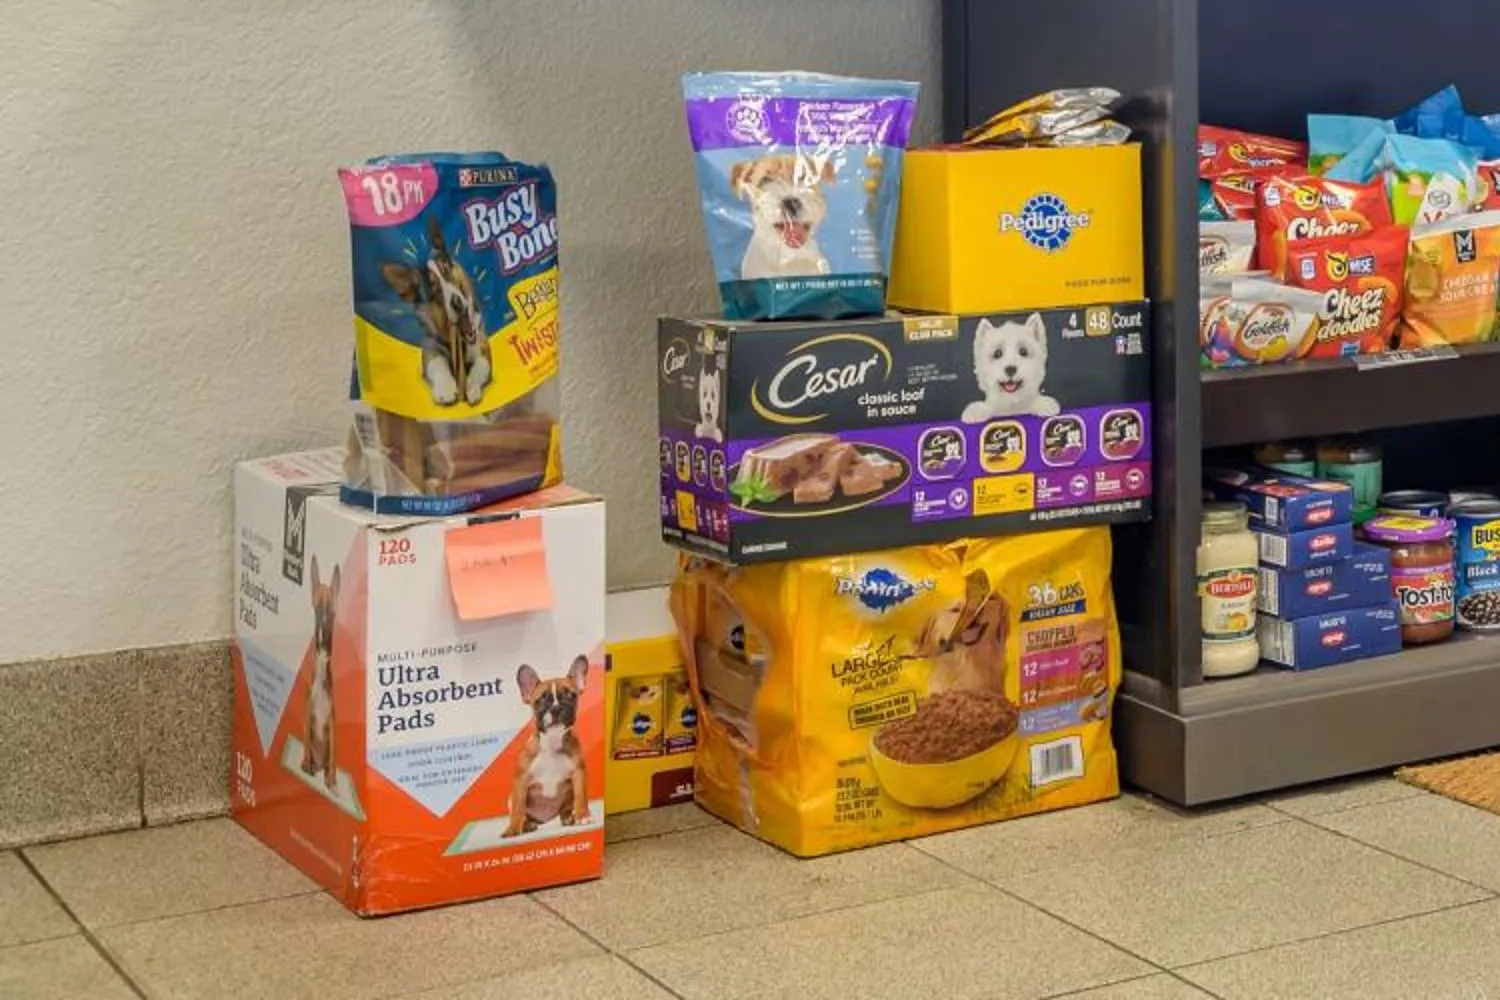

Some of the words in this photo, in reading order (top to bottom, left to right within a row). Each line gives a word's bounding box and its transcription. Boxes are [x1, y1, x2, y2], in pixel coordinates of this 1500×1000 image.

[362, 172, 403, 216] 18
[465, 183, 537, 245] Busy
[1000, 209, 1090, 236] Pedigree
[1468, 283, 1497, 297] CREA
[1325, 286, 1384, 317] Cheez
[1069, 312, 1077, 328] 4
[1089, 312, 1108, 330] 48
[1112, 311, 1143, 328] Count
[1243, 319, 1290, 338] Goldfish
[769, 354, 879, 408] Cesar
[858, 391, 897, 405] classic
[901, 388, 925, 402] loaf
[867, 406, 878, 417] in
[881, 404, 917, 416] sauce
[379, 538, 411, 556] 120
[379, 553, 417, 567] PADS
[1467, 562, 1499, 578] Black
[377, 642, 479, 663] MULTI-PURPOSE
[378, 664, 440, 687] Ultra
[1023, 660, 1038, 677] 12
[377, 677, 504, 711] Absorbent
[377, 709, 436, 735] Pads
